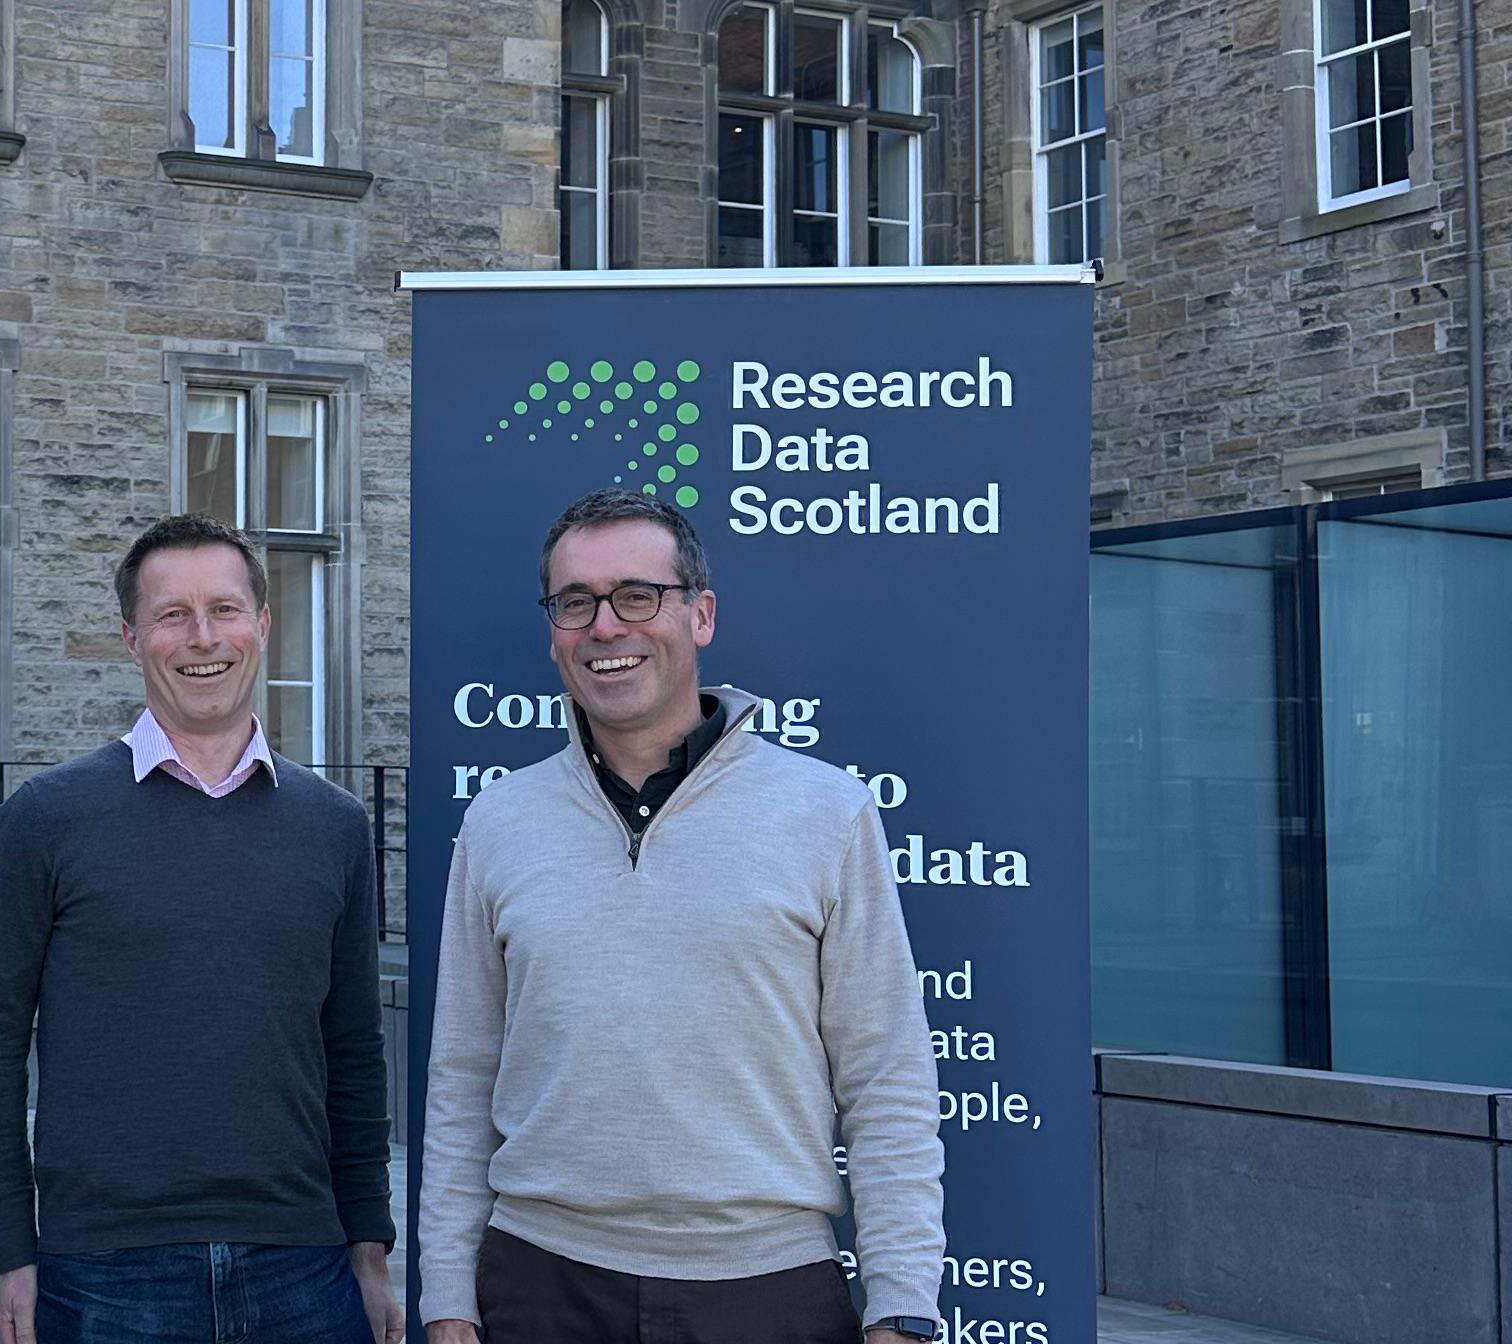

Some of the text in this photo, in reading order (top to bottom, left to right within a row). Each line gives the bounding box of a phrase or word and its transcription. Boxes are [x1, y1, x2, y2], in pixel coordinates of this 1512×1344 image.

[732, 356, 1014, 410] Research
[731, 423, 870, 472] Data
[729, 483, 1000, 535] Scotland
[888, 834, 1031, 887] data
[929, 1025, 996, 1061] ata
[938, 1081, 1042, 1131] ople,
